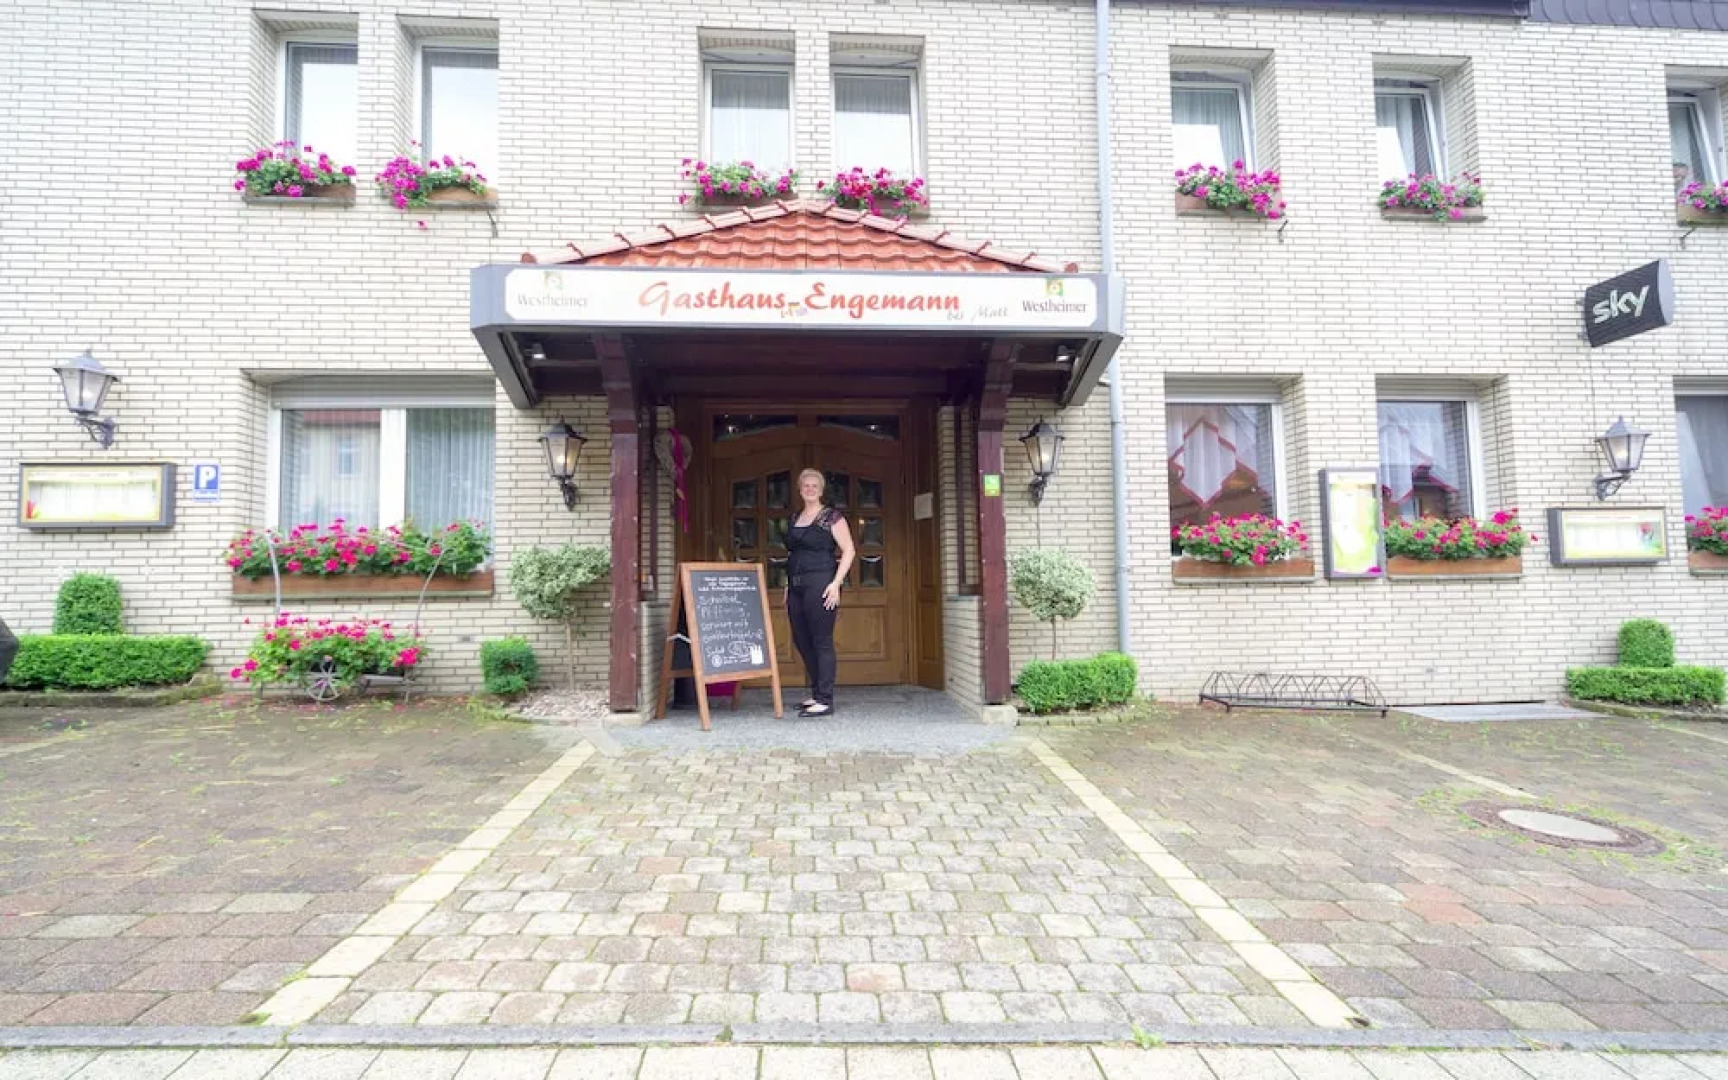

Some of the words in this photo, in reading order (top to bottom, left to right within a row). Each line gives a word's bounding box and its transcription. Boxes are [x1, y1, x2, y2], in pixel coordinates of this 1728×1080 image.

[638, 281, 786, 316] Gasthaus
[804, 281, 960, 318] Engemann
[1022, 299, 1088, 313] Westheimer
[1592, 284, 1650, 324] sky
[200, 466, 217, 488] P
